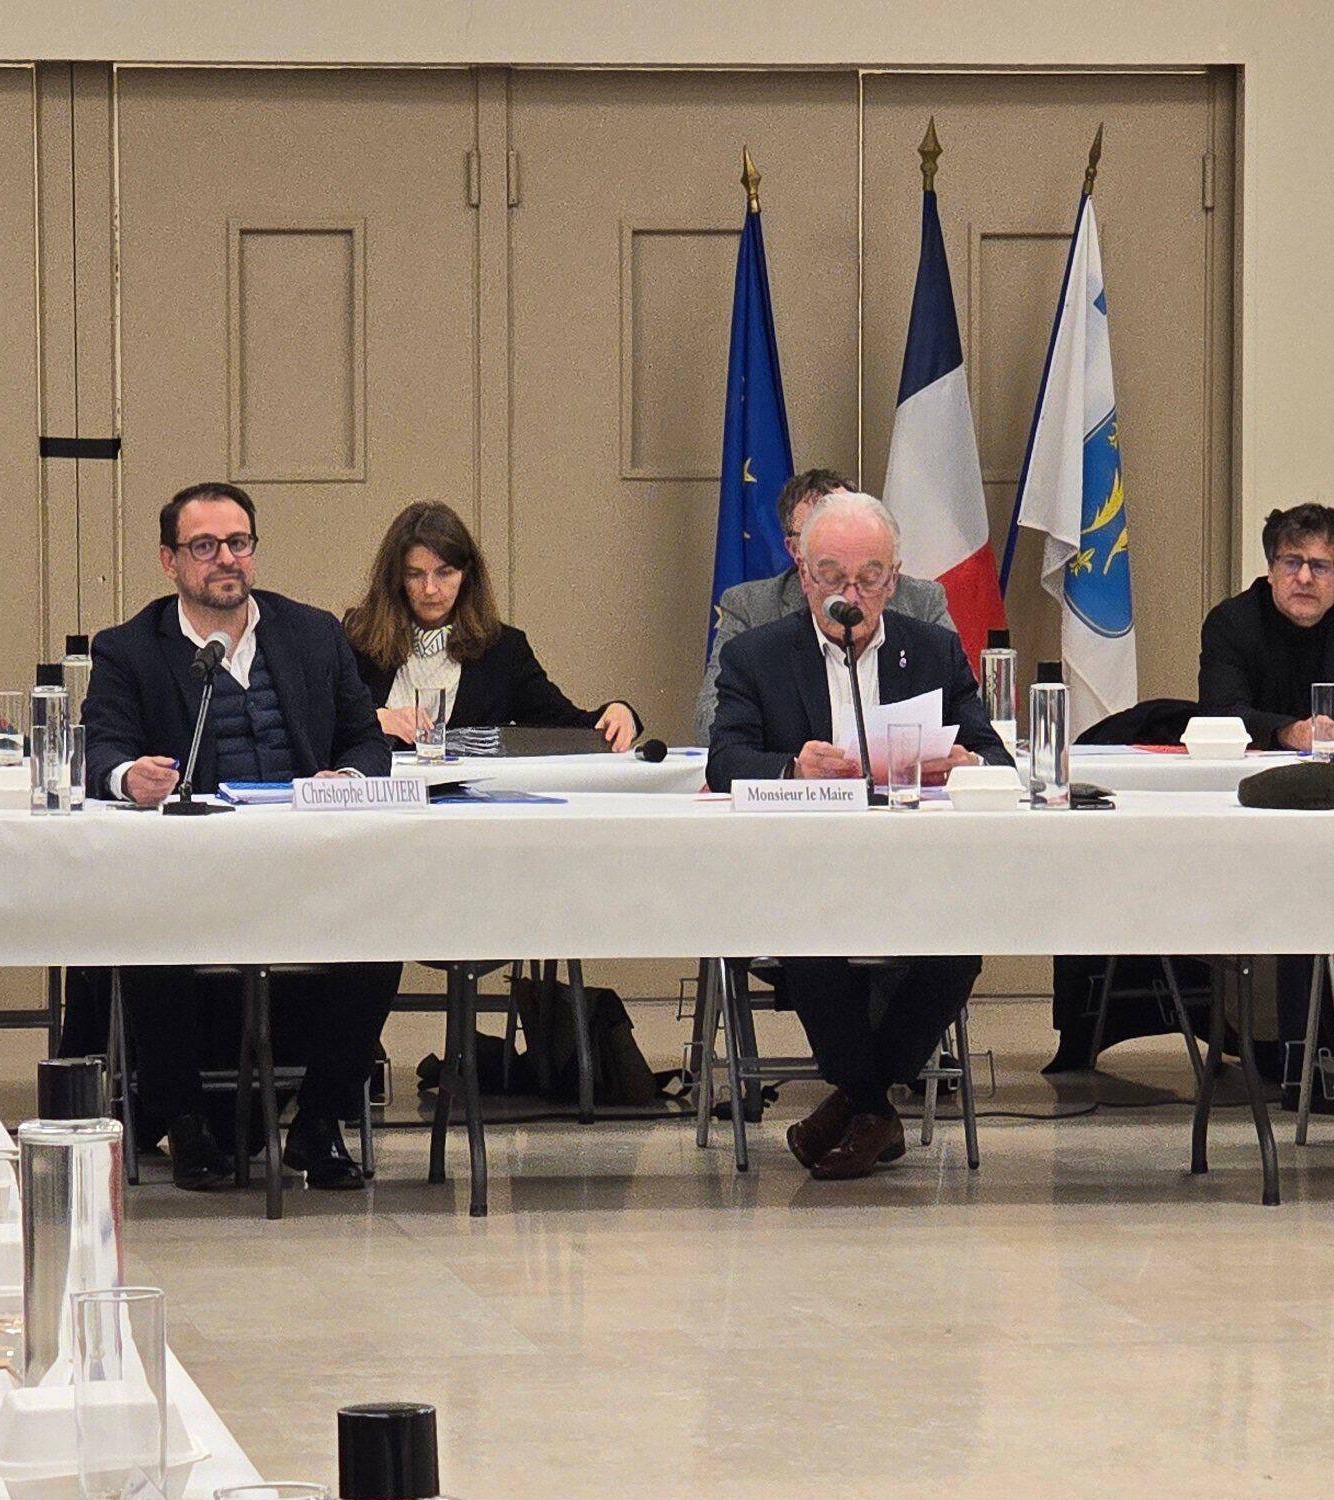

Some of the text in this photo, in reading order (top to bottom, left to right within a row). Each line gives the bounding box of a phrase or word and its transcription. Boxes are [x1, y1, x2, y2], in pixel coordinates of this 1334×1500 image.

[301, 779, 420, 807] Christophe ULIVIERI
[747, 786, 854, 801] Monsieur le Maire
